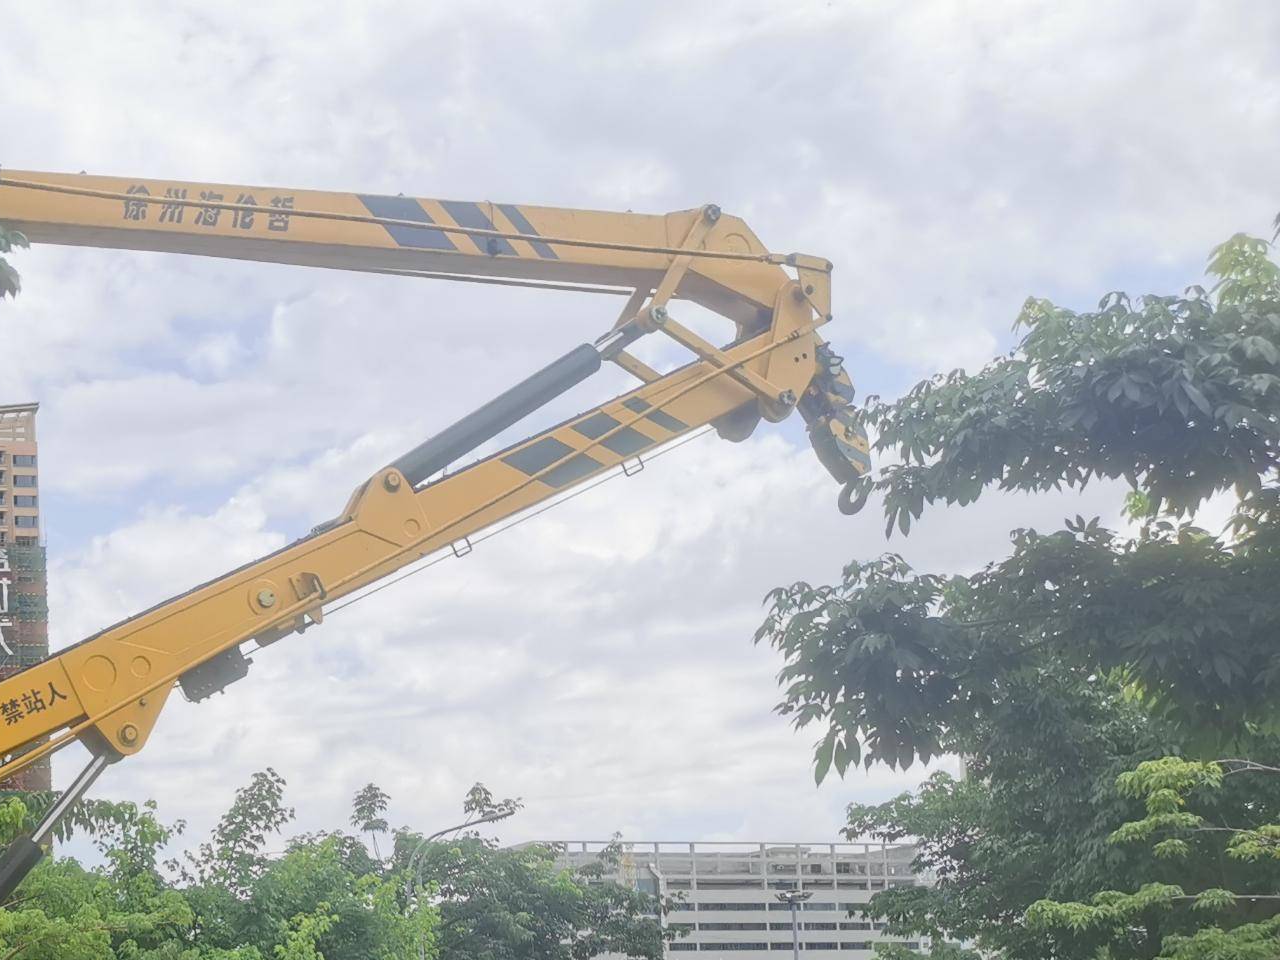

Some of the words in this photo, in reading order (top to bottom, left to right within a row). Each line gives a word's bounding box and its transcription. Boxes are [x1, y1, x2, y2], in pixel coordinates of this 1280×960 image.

[123, 184, 295, 232] 徐州海伦哲
